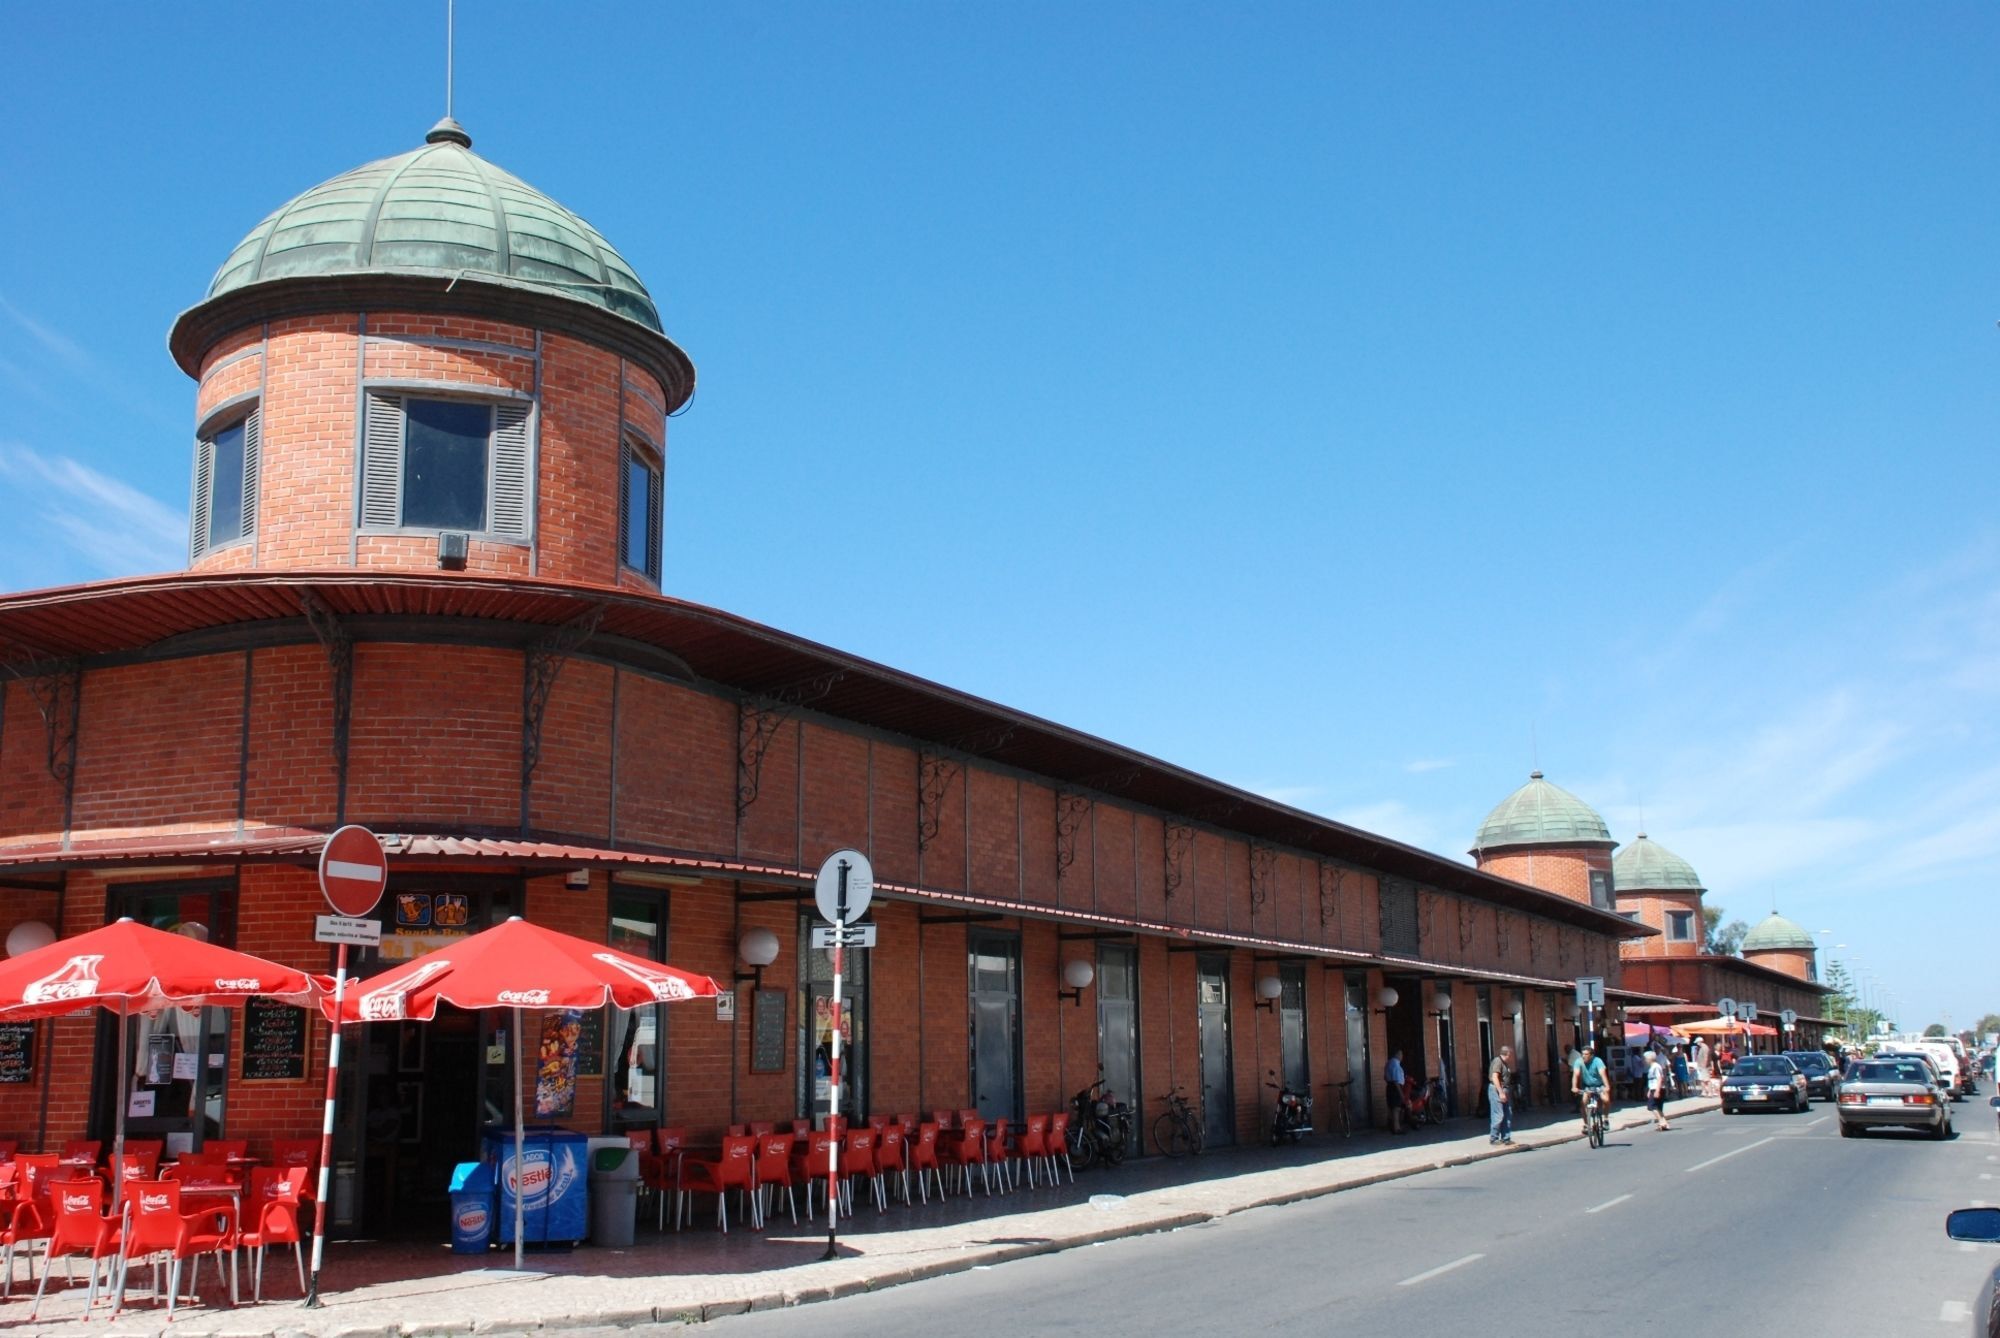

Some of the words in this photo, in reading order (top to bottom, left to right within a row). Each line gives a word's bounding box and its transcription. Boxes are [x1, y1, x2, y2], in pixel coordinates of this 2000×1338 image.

[395, 927, 435, 937] Snack
[442, 928, 466, 937] Bar
[497, 989, 550, 1004] Coca-Cola
